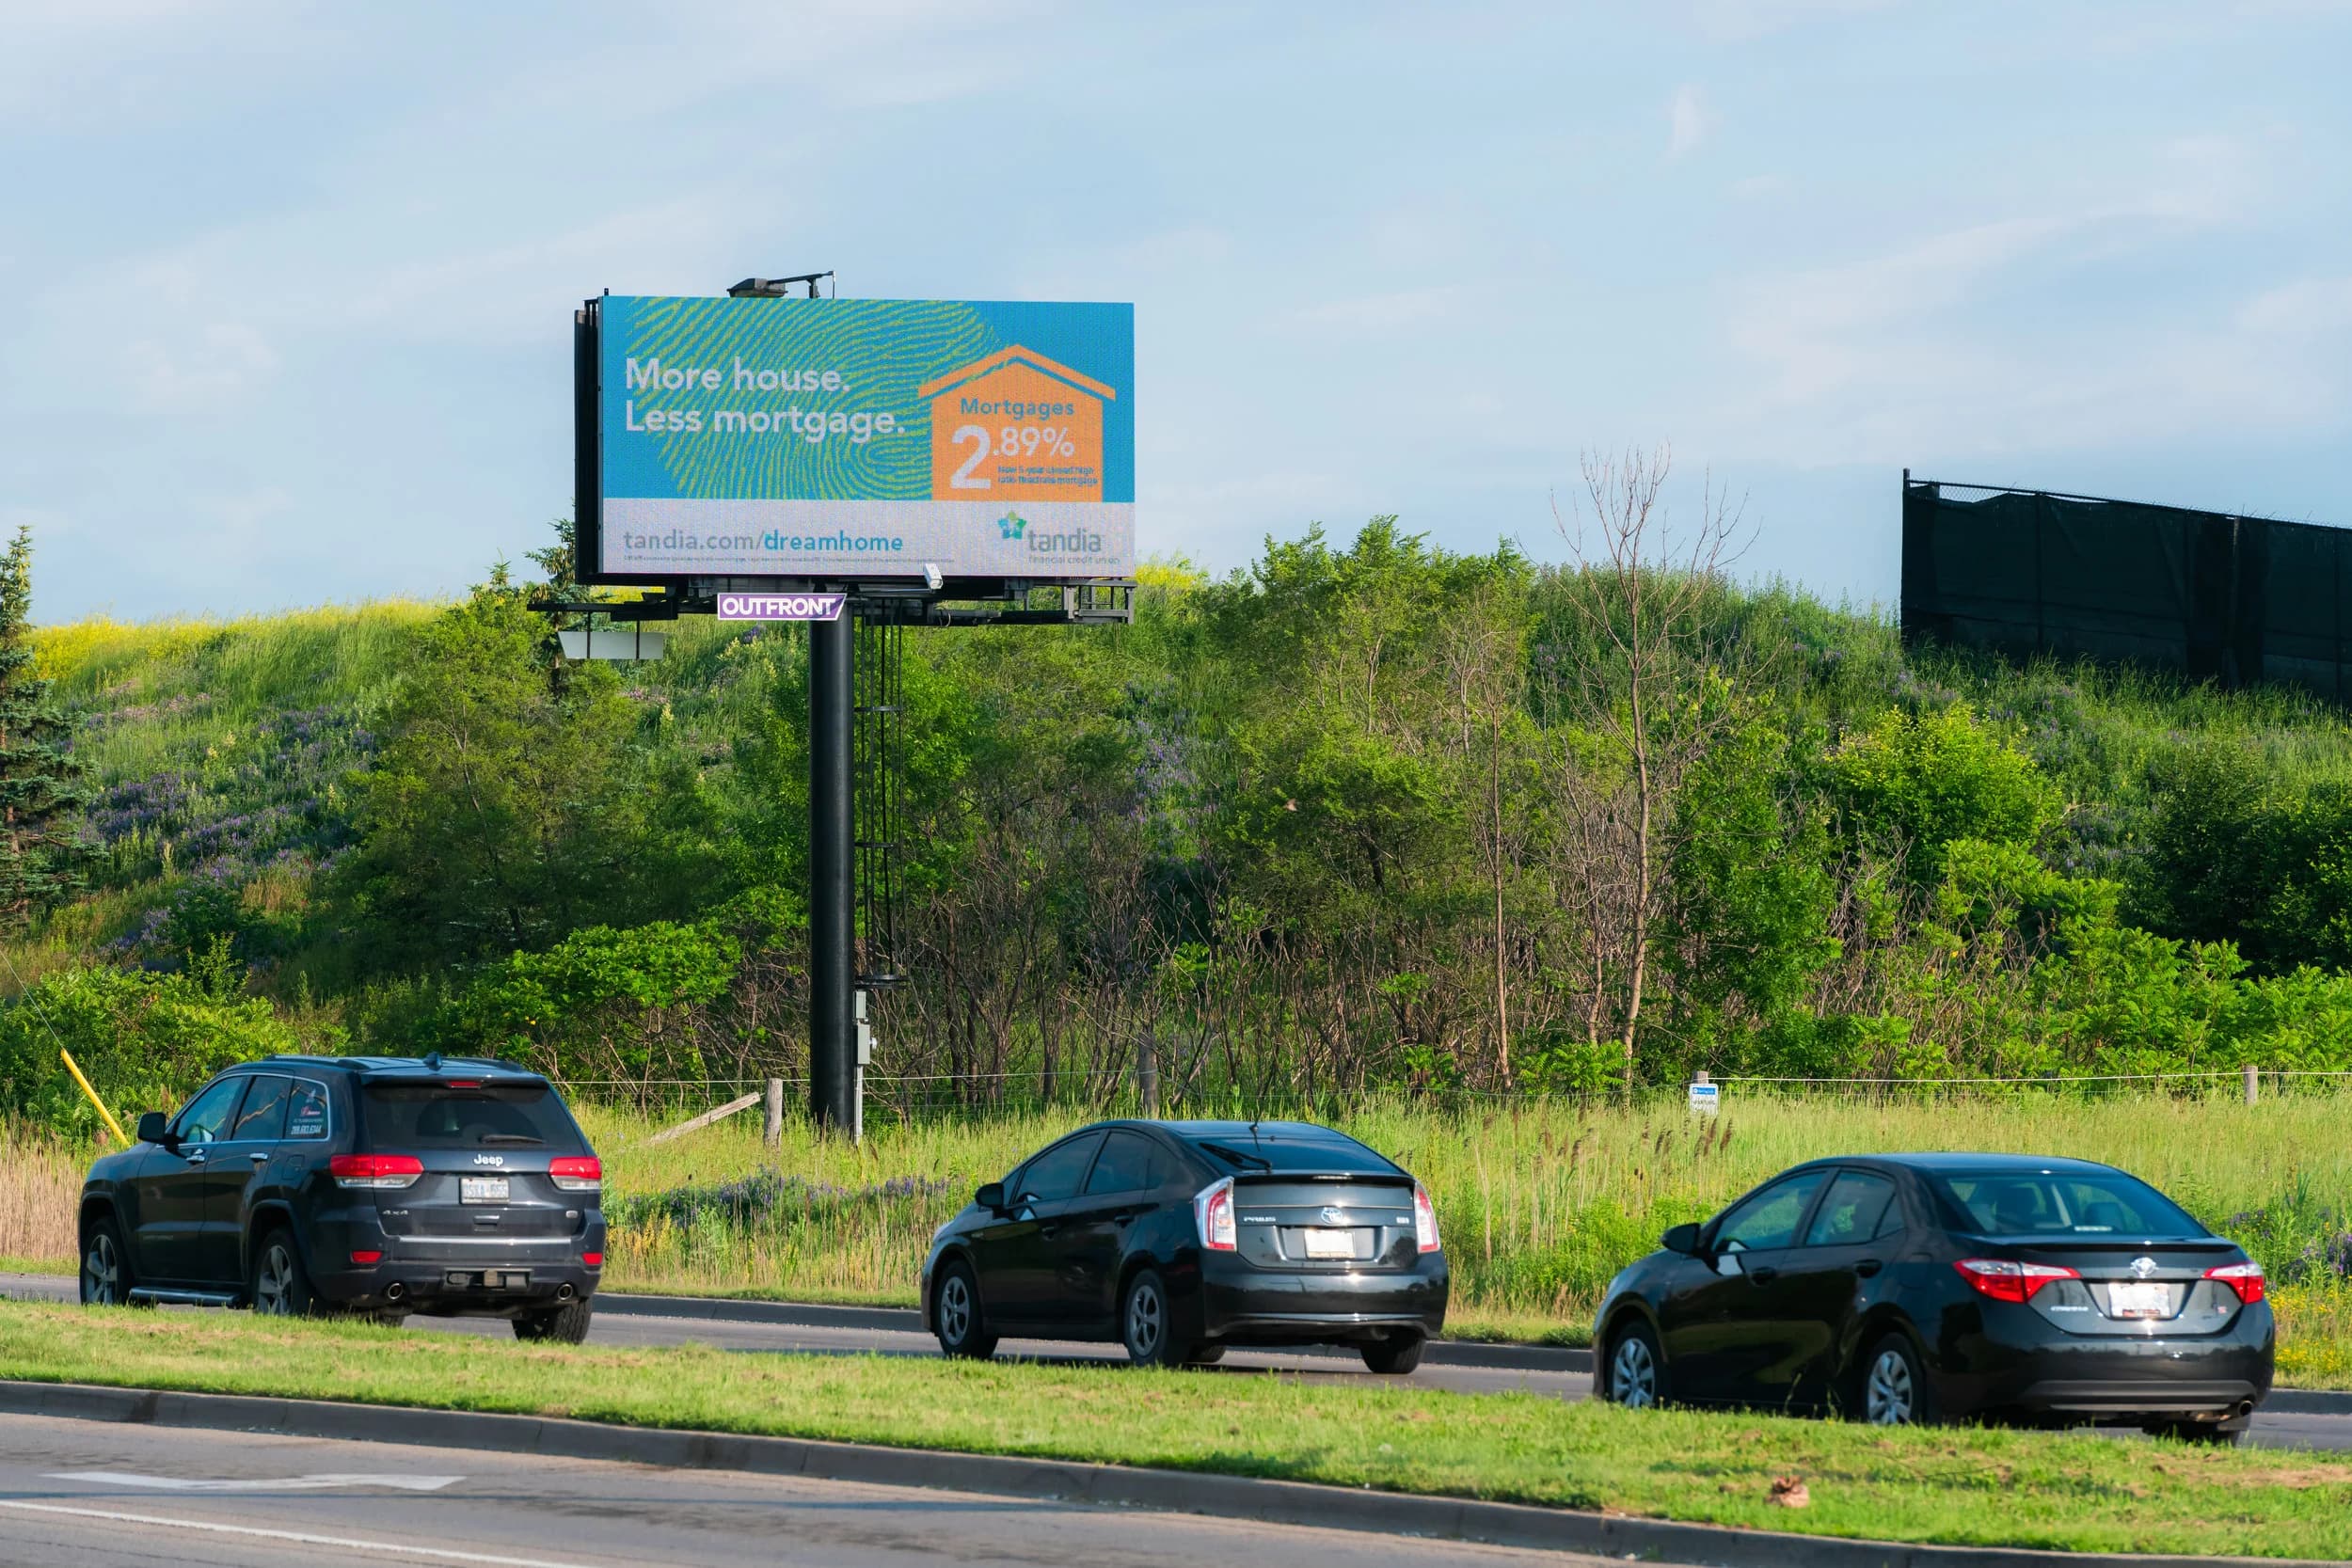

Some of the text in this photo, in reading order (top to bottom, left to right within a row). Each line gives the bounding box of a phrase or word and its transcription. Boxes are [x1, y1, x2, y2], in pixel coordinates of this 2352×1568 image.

[626, 356, 850, 392] More house.
[960, 398, 1075, 420] Mortgages
[626, 400, 905, 443] Less mortgage.
[624, 530, 903, 551] tandia.com/dreamhome
[1028, 528, 1102, 553] tandia
[723, 597, 836, 616] OUTFRONT
[473, 1153, 504, 1167] Jeep
